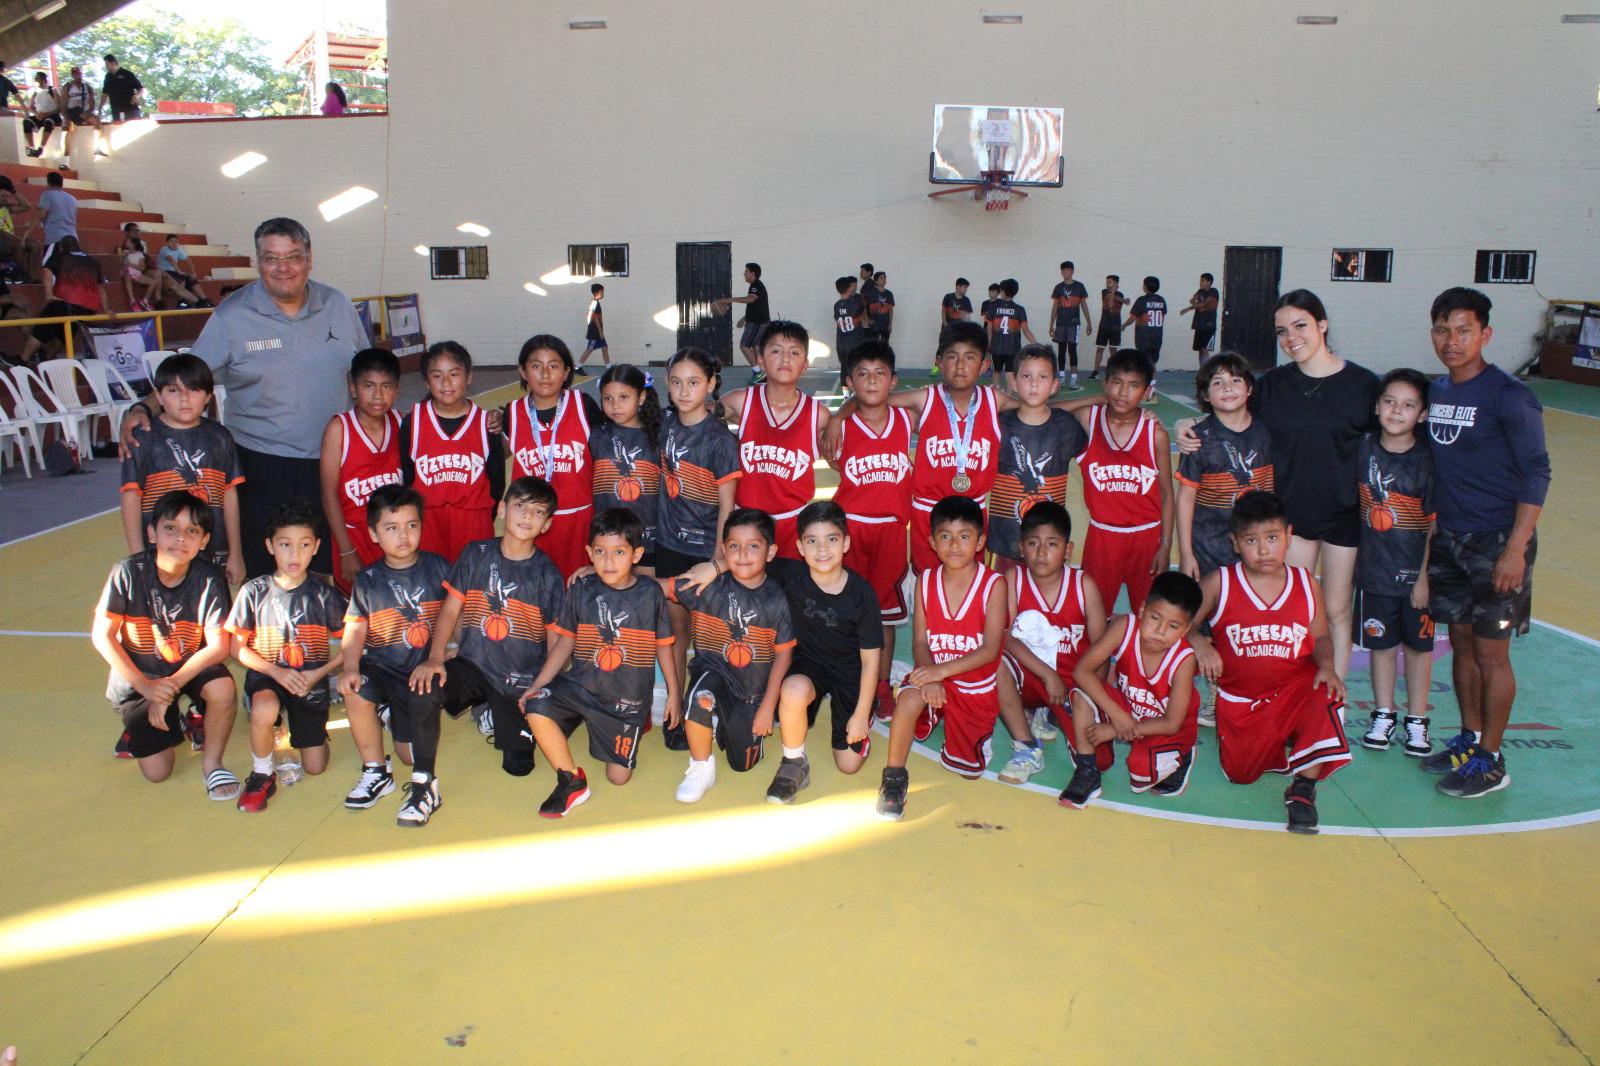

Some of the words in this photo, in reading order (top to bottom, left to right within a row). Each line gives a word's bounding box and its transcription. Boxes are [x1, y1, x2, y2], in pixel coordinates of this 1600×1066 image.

[838, 316, 854, 333] 18
[1000, 315, 1009, 335] 4
[1147, 310, 1163, 327] 30
[1454, 406, 1477, 421] ELITE
[415, 451, 485, 487] AZTECAS
[741, 440, 811, 482] AZTECAS
[845, 450, 910, 487] AZTECAS
[433, 470, 469, 485] ACADEMIA
[757, 462, 791, 480] ACADEMIA
[1105, 481, 1140, 495] CADEMIA
[926, 629, 984, 652] ZTECA
[1225, 621, 1309, 660] AZTECAS
[1245, 644, 1291, 660] ACADEMIA
[745, 744, 761, 770] 17
